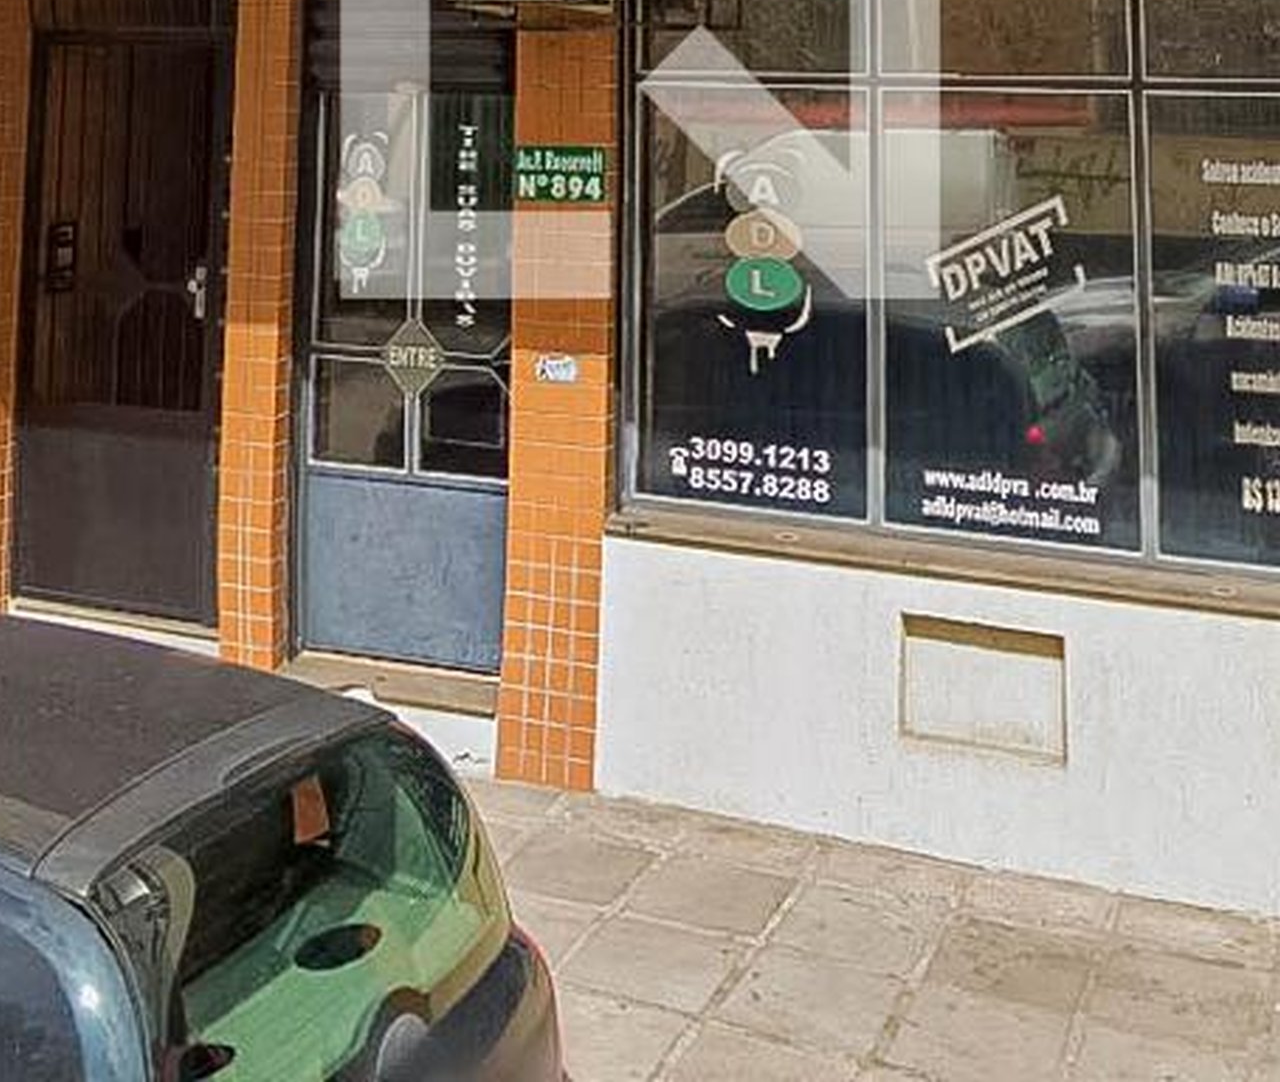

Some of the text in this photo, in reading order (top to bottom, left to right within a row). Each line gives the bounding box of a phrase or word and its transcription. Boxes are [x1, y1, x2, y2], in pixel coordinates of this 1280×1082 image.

[941, 217, 1055, 301] DPVAT
[689, 436, 831, 473] 3099.1213
[689, 467, 831, 503] 8557.8288
